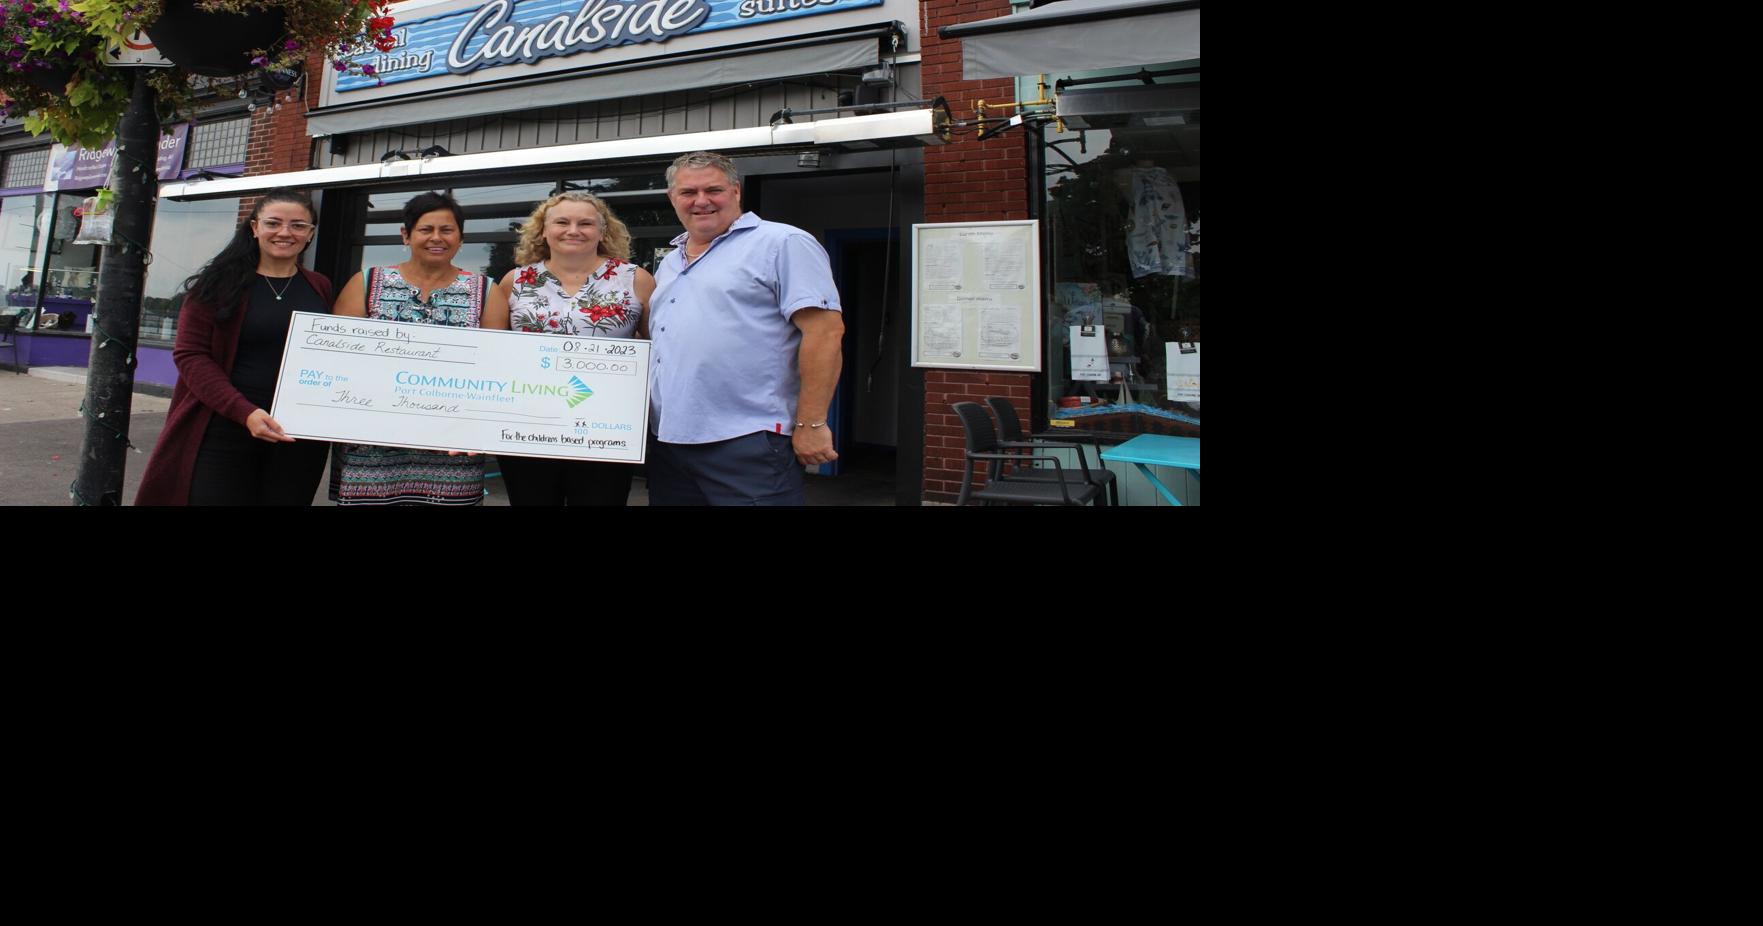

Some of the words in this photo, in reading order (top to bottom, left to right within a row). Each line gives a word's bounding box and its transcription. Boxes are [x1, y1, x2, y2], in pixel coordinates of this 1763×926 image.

[449, 0, 703, 67] Canalside
[311, 318, 347, 333] Funds
[352, 327, 389, 337] raised
[306, 333, 366, 352] Canalside
[375, 341, 441, 359] Restaurant
[540, 356, 551, 369] $
[300, 369, 324, 379] PAY
[394, 386, 416, 395] Port
[396, 371, 508, 392] COMMUNITY
[511, 380, 570, 397] LIVING
[331, 390, 374, 407] Three
[392, 395, 460, 413] Thousand
[591, 421, 633, 432] DOLLARS
[501, 429, 512, 440] For
[515, 431, 526, 441] the
[560, 434, 584, 444] based
[587, 438, 627, 449] programs
